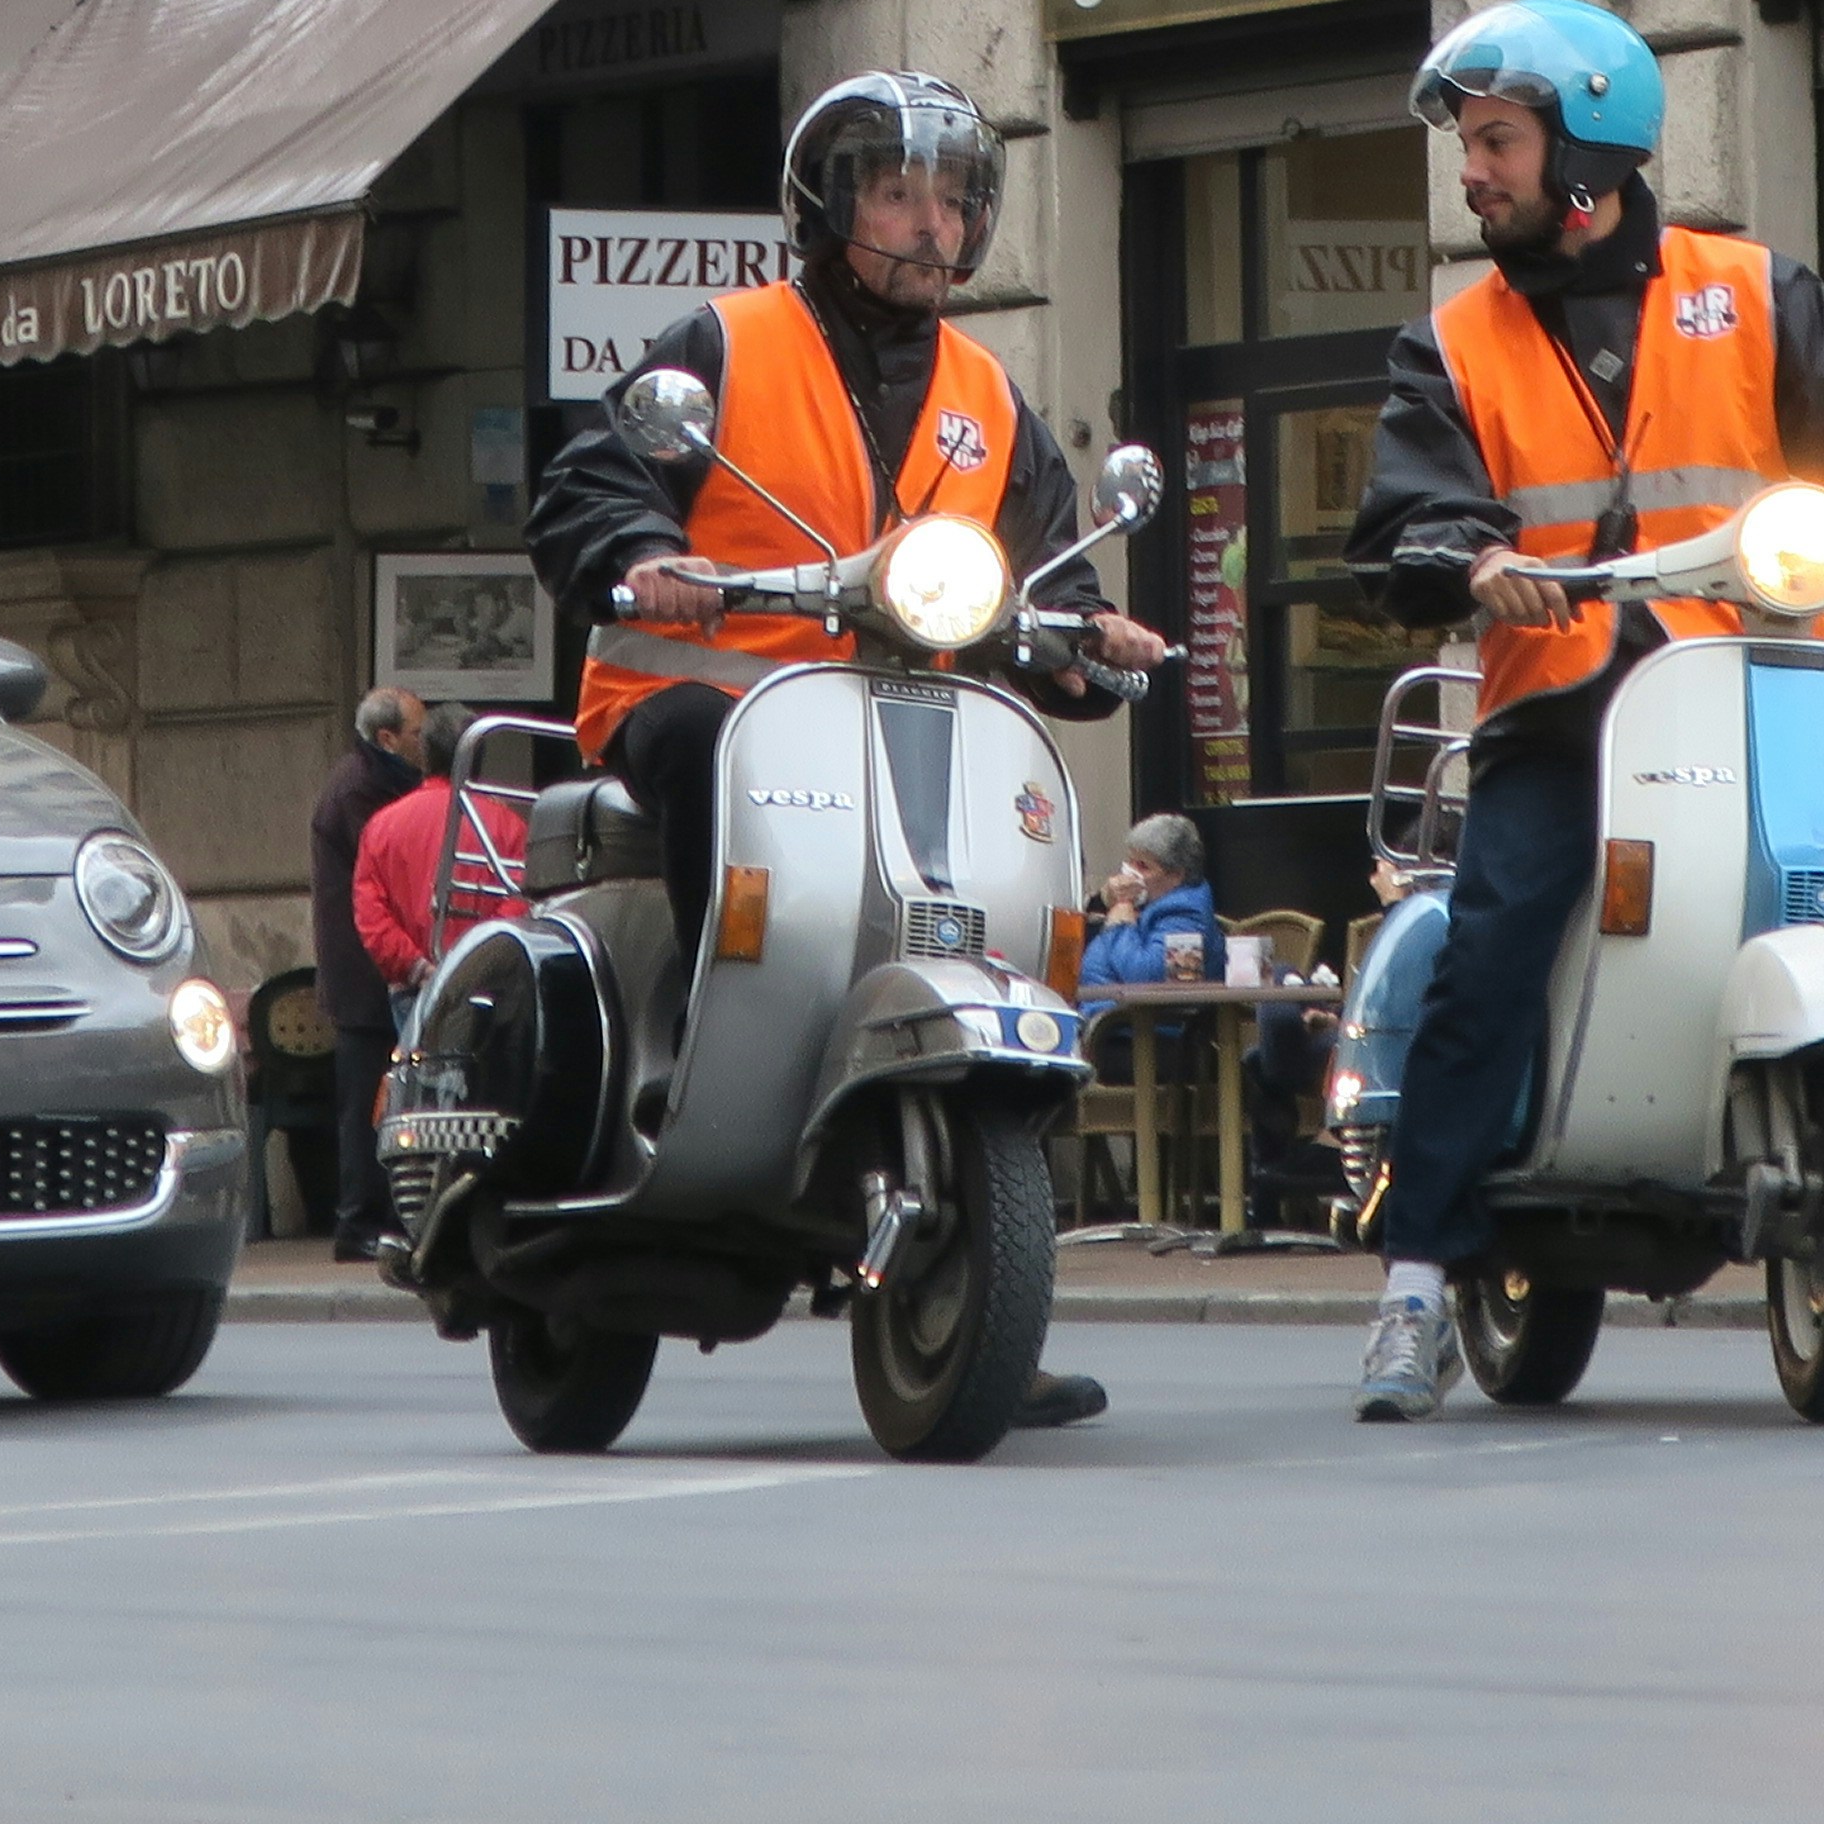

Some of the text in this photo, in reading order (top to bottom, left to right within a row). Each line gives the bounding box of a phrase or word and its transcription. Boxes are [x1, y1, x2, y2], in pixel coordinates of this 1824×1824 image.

[537, 2, 709, 73] PIZZERIA
[557, 236, 789, 287] PIZZERI
[1, 294, 40, 347] da
[80, 251, 247, 335] LORETO
[561, 336, 627, 373] DA
[1632, 764, 1736, 787] vespa
[747, 788, 854, 811] vespa
